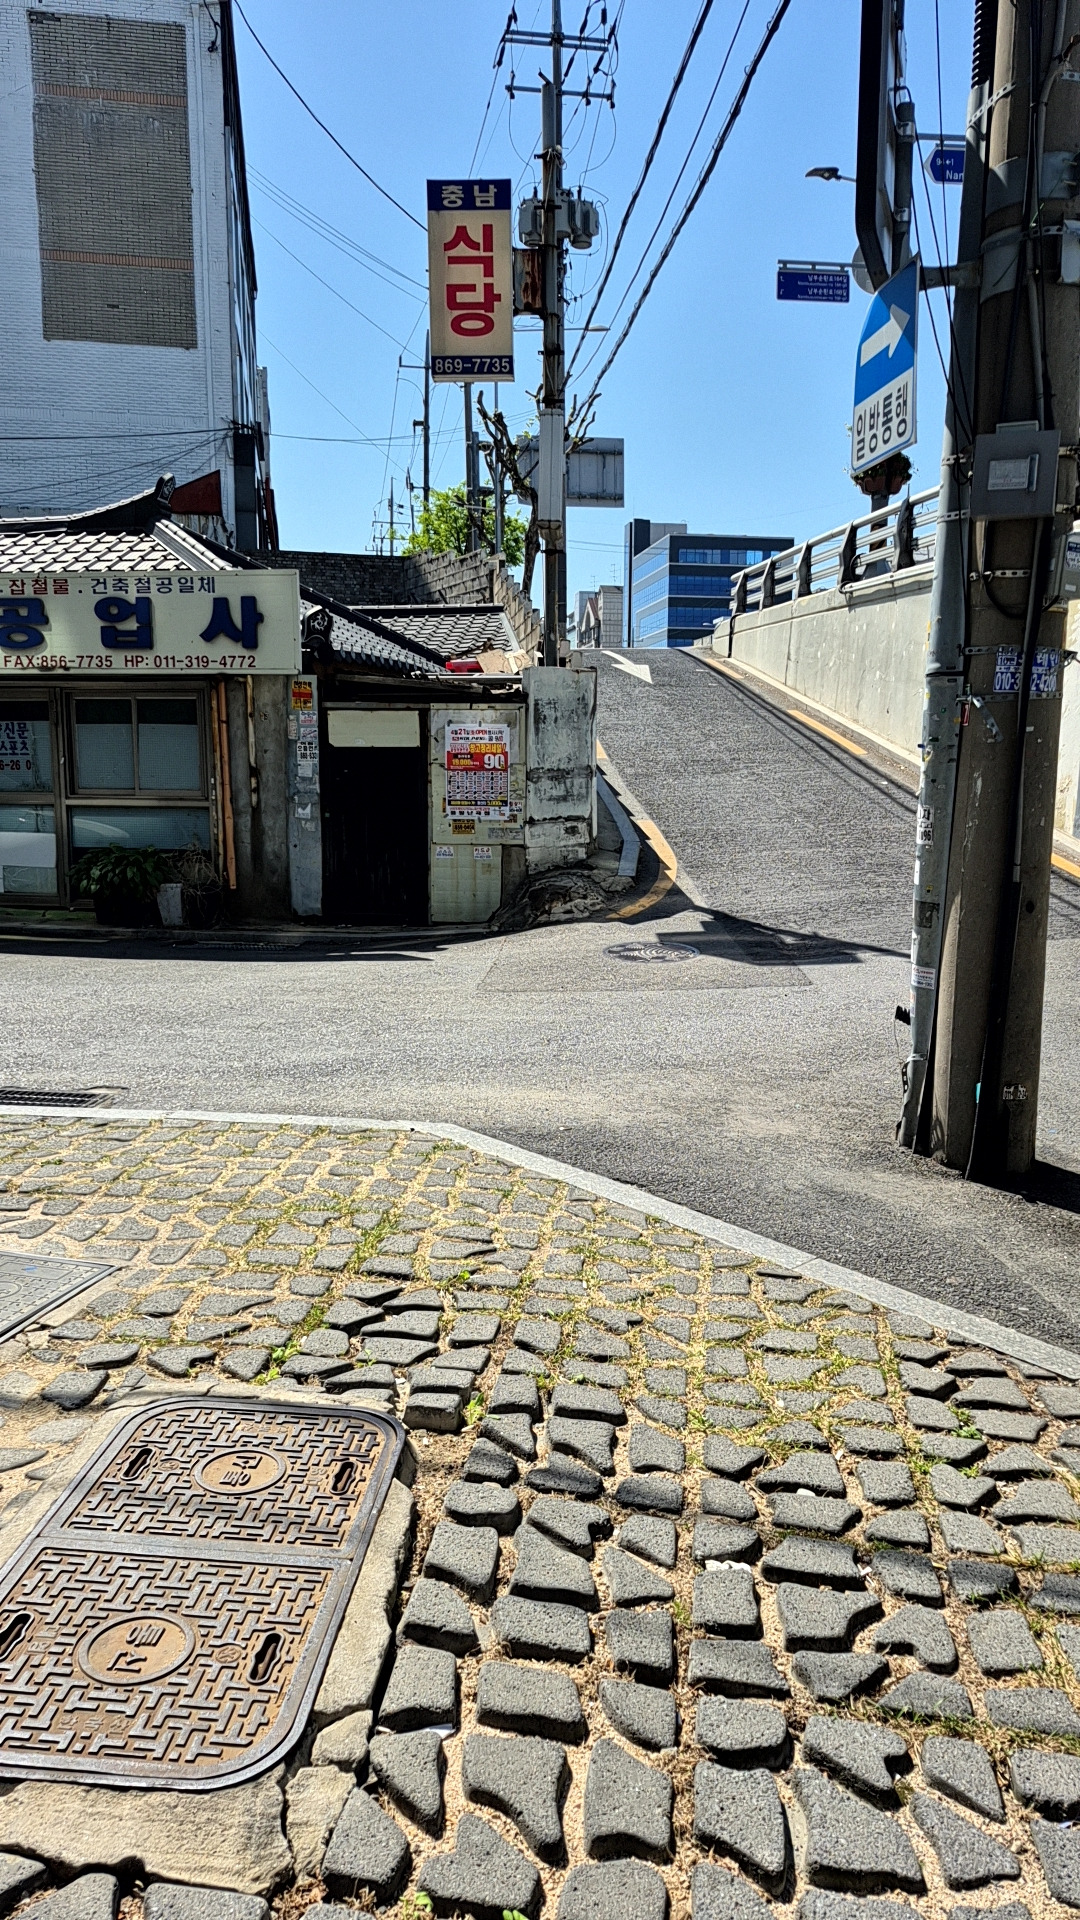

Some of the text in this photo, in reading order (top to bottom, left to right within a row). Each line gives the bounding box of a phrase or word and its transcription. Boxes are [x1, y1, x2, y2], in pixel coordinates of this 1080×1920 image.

[441, 184, 497, 208] 충남
[443, 223, 502, 337] 식당
[434, 358, 510, 373] 869-7735
[855, 381, 908, 463] 일방통행
[8, 576, 216, 596] 잡철물 건축철공일체
[4, 655, 257, 668] FAX:856-7735 HP: 011-319-4772
[0, 722, 29, 739] 신문
